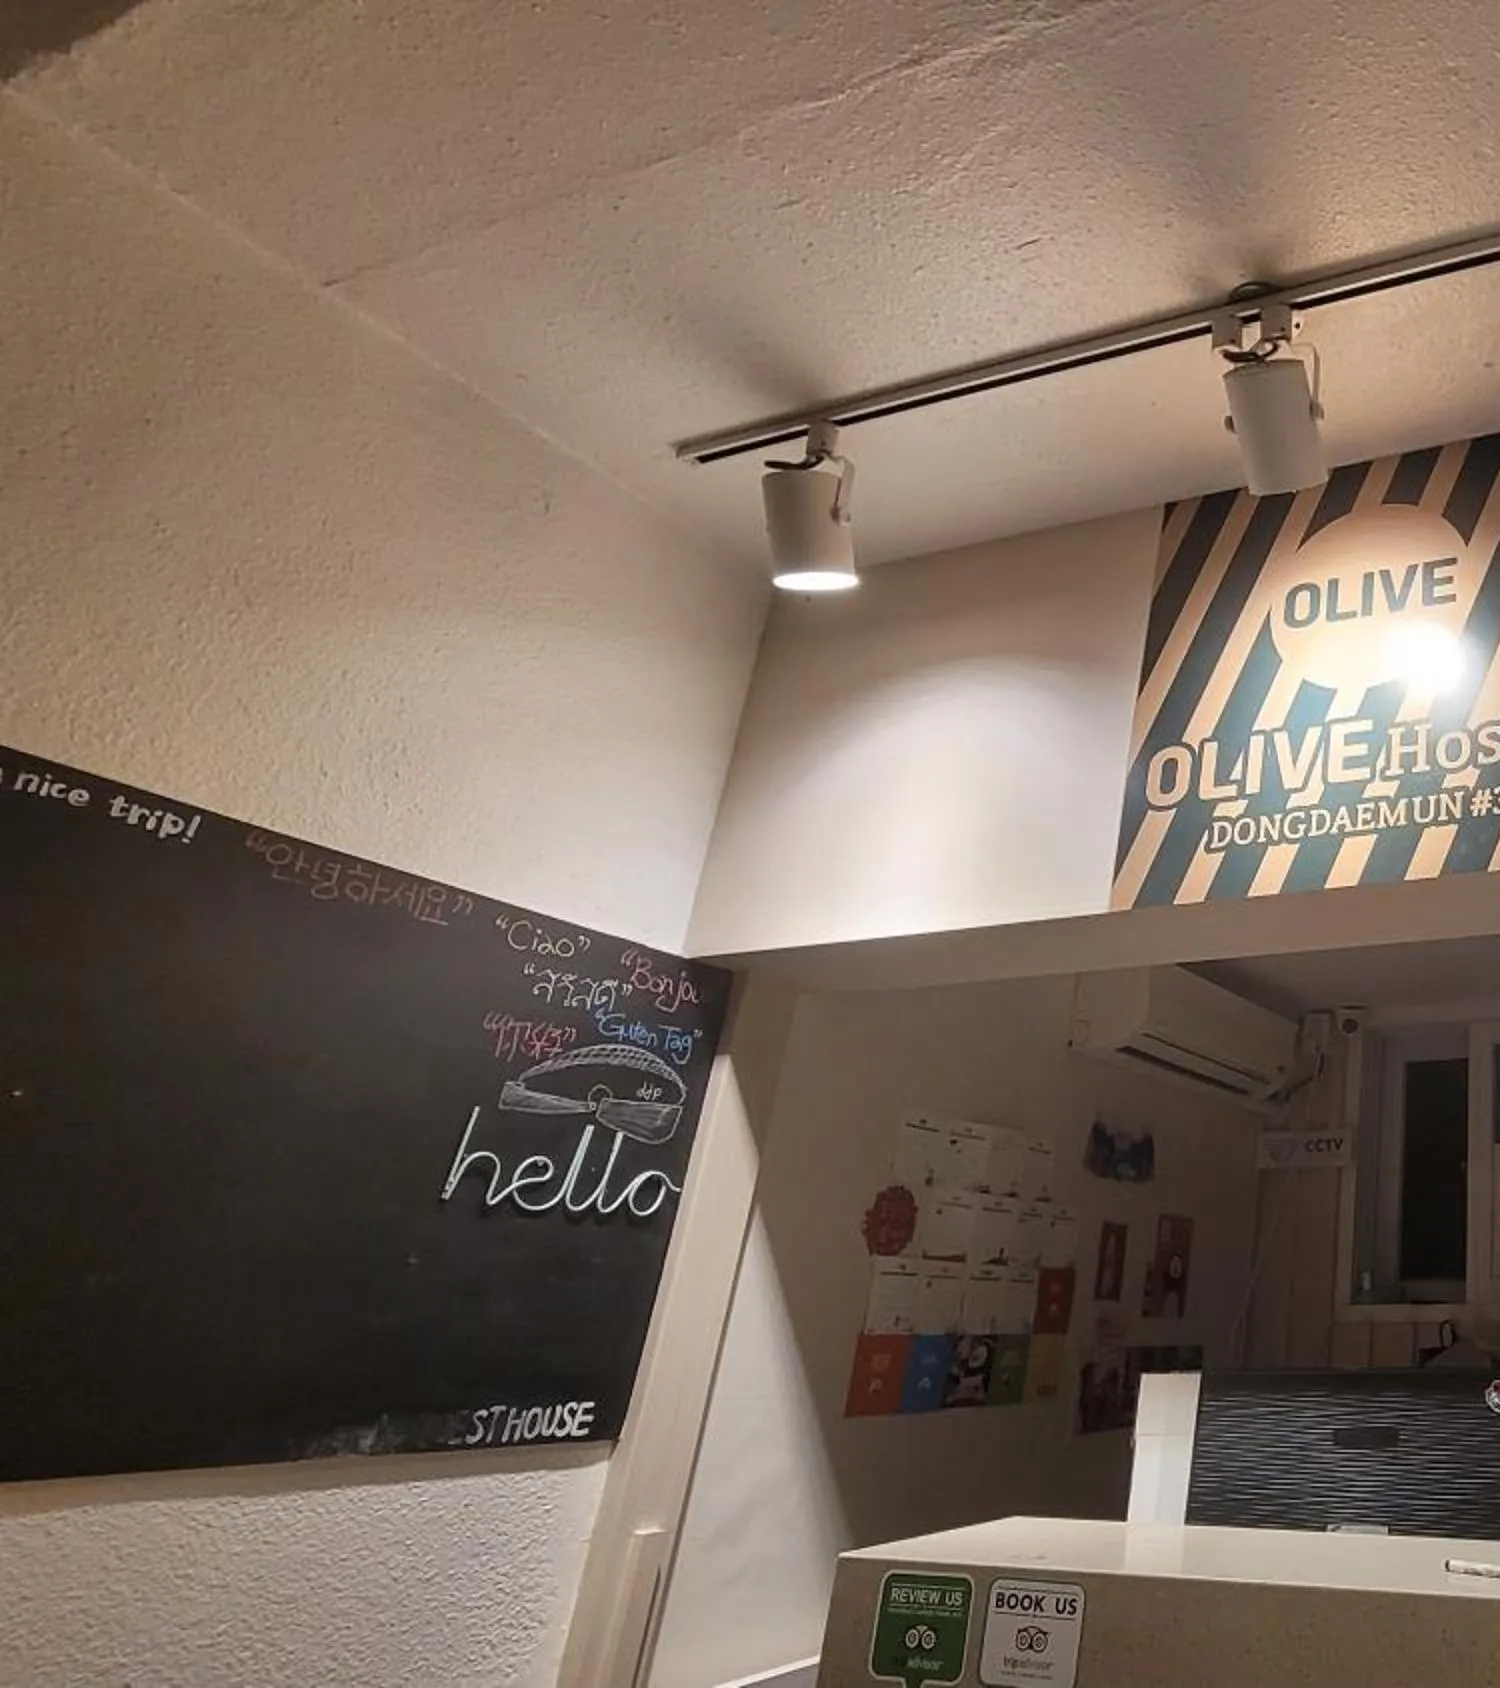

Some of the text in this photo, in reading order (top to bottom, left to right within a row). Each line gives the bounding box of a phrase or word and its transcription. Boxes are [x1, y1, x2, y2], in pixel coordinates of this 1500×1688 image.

[1283, 557, 1458, 629] OLIVE
[1145, 716, 1375, 808] OLIVE
[14, 771, 201, 844] nice trip!
[1210, 791, 1465, 850] DONGDAEMUN
[441, 1105, 682, 1217] hello
[1304, 1137, 1344, 1153] CCTV
[890, 1587, 963, 1606] REVIEW US
[995, 1592, 1077, 1616] BOOK US
